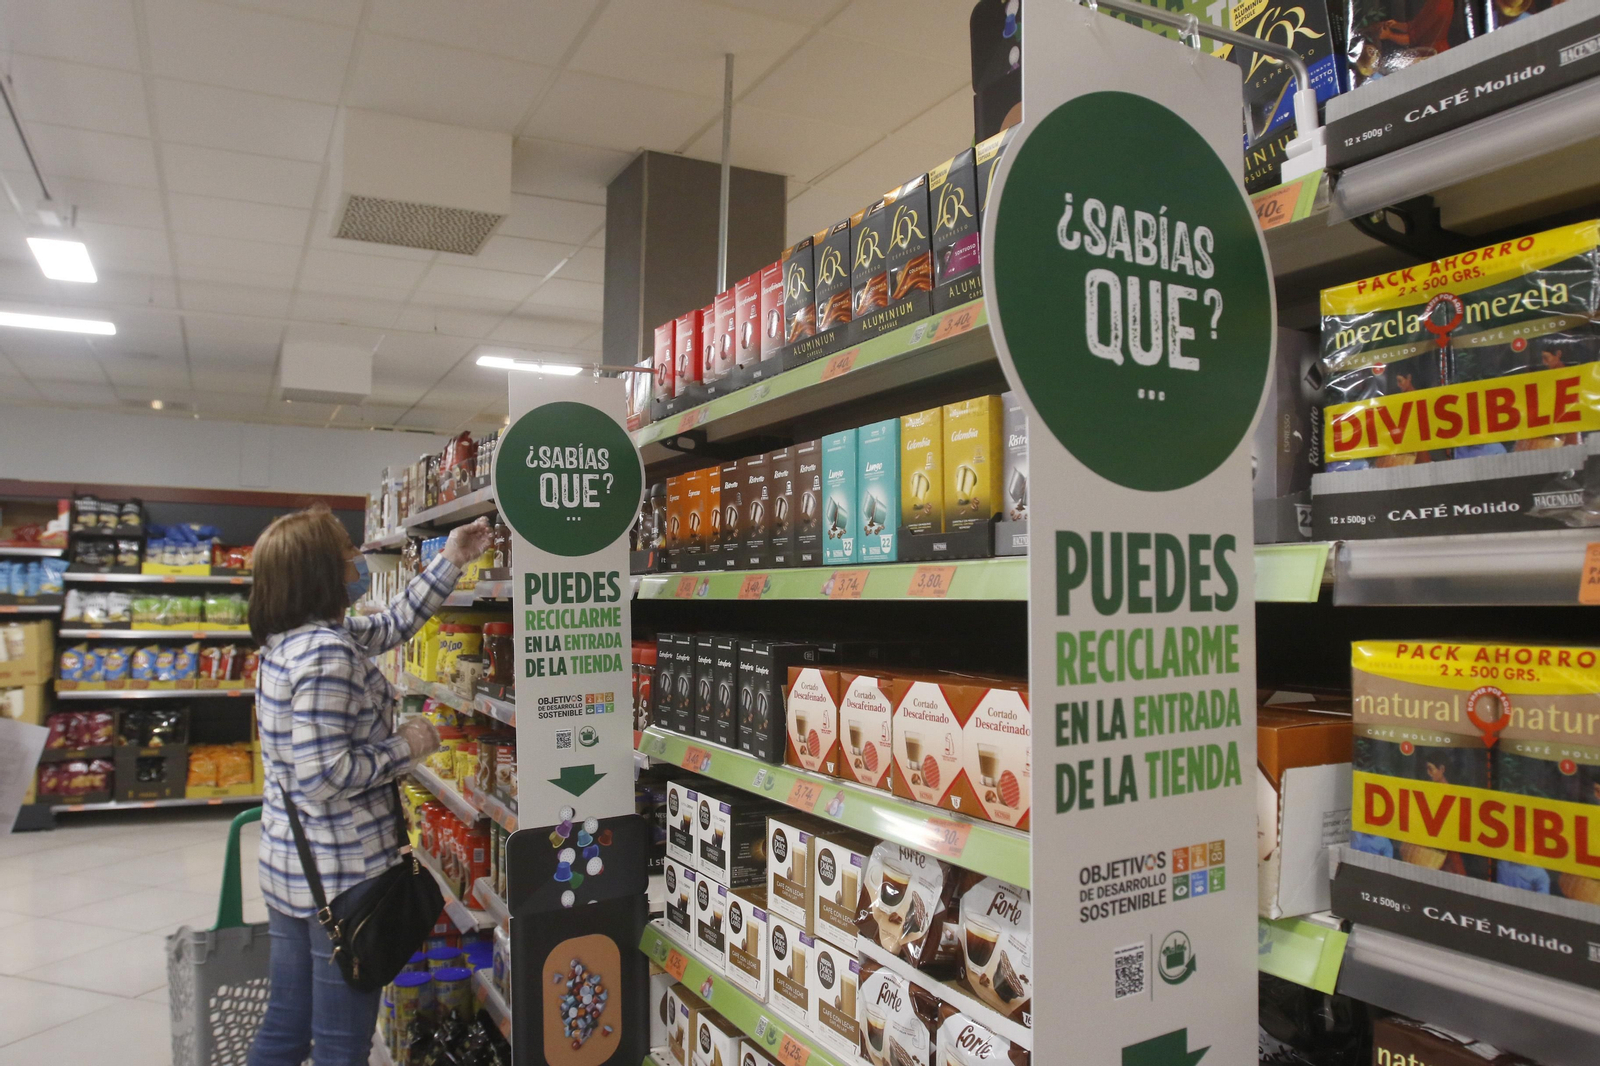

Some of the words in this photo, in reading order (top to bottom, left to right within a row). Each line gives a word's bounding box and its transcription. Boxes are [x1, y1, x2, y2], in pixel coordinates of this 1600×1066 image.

[1234, 9, 1257, 27] CAPSULE
[1255, 48, 1315, 88] ESPRESO
[1403, 88, 1470, 124] CAFÉ
[1473, 63, 1547, 98] Molido
[1343, 137, 1354, 148] 12
[1355, 135, 1361, 143] x
[1362, 126, 1383, 141] 500g
[1244, 164, 1273, 184] PSULE
[1256, 200, 1284, 219] 40€
[1057, 192, 1216, 280] ¿SABÍAS
[1357, 267, 1417, 295] PACK
[1428, 236, 1536, 277] AHORRO
[949, 279, 982, 298] ALUMI
[1397, 286, 1405, 298] 2
[1409, 284, 1418, 294] x
[1422, 275, 1448, 292] 500
[1454, 264, 1485, 283] GRS.
[862, 302, 914, 331] ALUMINIUM
[1084, 268, 1223, 372] QUE?
[1334, 310, 1421, 350] mezcla
[1465, 278, 1569, 325] mezcla
[878, 321, 898, 332] CAPSULE
[1471, 331, 1504, 344] CAFÉ
[1513, 320, 1567, 336] MOLIDO
[793, 332, 835, 356] ALUMINIUM
[1373, 346, 1417, 362] MOLIDO
[1332, 375, 1582, 453] DIVISIBLE
[906, 437, 931, 451] Colombia
[950, 428, 979, 442] Colombia
[1308, 406, 1320, 466] Ristretto
[525, 442, 610, 470] ¿SABÍAS
[773, 469, 789, 479] Ristretto
[800, 463, 817, 474] Ristretto
[828, 468, 844, 480] Lungo
[865, 461, 883, 473] Lungo
[748, 475, 765, 484] Ristretto
[539, 471, 615, 510] QUE?
[1329, 516, 1339, 525] 12
[1340, 516, 1346, 524] x
[1346, 513, 1367, 525] 500g
[1388, 503, 1448, 522] CAFÉ
[1453, 500, 1520, 516] Molido
[843, 541, 852, 551] 22
[881, 537, 891, 548] 22
[1055, 529, 1239, 616] PUEDES
[524, 570, 622, 605] PUEDES
[525, 606, 622, 631] RECICLARME
[525, 635, 542, 653] EN
[545, 634, 562, 652] LA
[564, 631, 623, 651] ENTRADA
[525, 656, 546, 678] DE
[548, 656, 568, 676] LA
[570, 653, 623, 674] TIENDA
[1056, 624, 1240, 687] RECICLARME
[1396, 643, 1461, 662] PACK
[1475, 647, 1596, 669] AHORRO
[1440, 664, 1449, 676] 2
[1455, 668, 1464, 677] x
[1470, 666, 1500, 679] 500
[1504, 668, 1541, 682] GRS.
[793, 690, 827, 703] Descafeinado
[800, 681, 819, 692] Cortado
[853, 689, 876, 700] Cortado
[1486, 686, 1502, 696] POR
[537, 694, 583, 706] OBJETIVOS
[546, 702, 583, 711] DESARROLLO
[846, 698, 887, 713] Descafeinado
[912, 698, 939, 710] Cortado
[538, 708, 583, 720] SOSTENIBLE
[903, 707, 950, 724] Descafeinado
[987, 707, 1018, 721] Cortado
[1055, 701, 1089, 747] EN
[1096, 697, 1128, 743] LA
[1133, 687, 1242, 738] ENTRADA
[1360, 693, 1460, 722] natural
[1508, 704, 1600, 736] natur
[975, 717, 1030, 737] Descafeinado
[1367, 727, 1395, 738] CAFÉ
[1402, 732, 1452, 744] MOLIDO
[1516, 744, 1551, 755] CAFÉ
[1561, 749, 1600, 760] MOLI
[1055, 759, 1095, 815] DE
[1103, 754, 1139, 807] LA
[1144, 740, 1242, 800] TIENDA
[1364, 782, 1600, 867] DIVISIBL
[1079, 851, 1167, 886] OBJETIVOS
[1079, 887, 1096, 903] DE
[1097, 872, 1167, 899] DESARROLLO
[1079, 888, 1167, 923] SOSTENIBLE
[1360, 892, 1371, 902] 12
[1372, 895, 1378, 903] x
[1379, 896, 1401, 911] 500g
[1422, 906, 1491, 933] CAFÉ
[1497, 924, 1573, 955] Molido
[833, 1013, 841, 1024] CON
[841, 1019, 855, 1033] LECHE
[853, 1045, 858, 1055] 7
